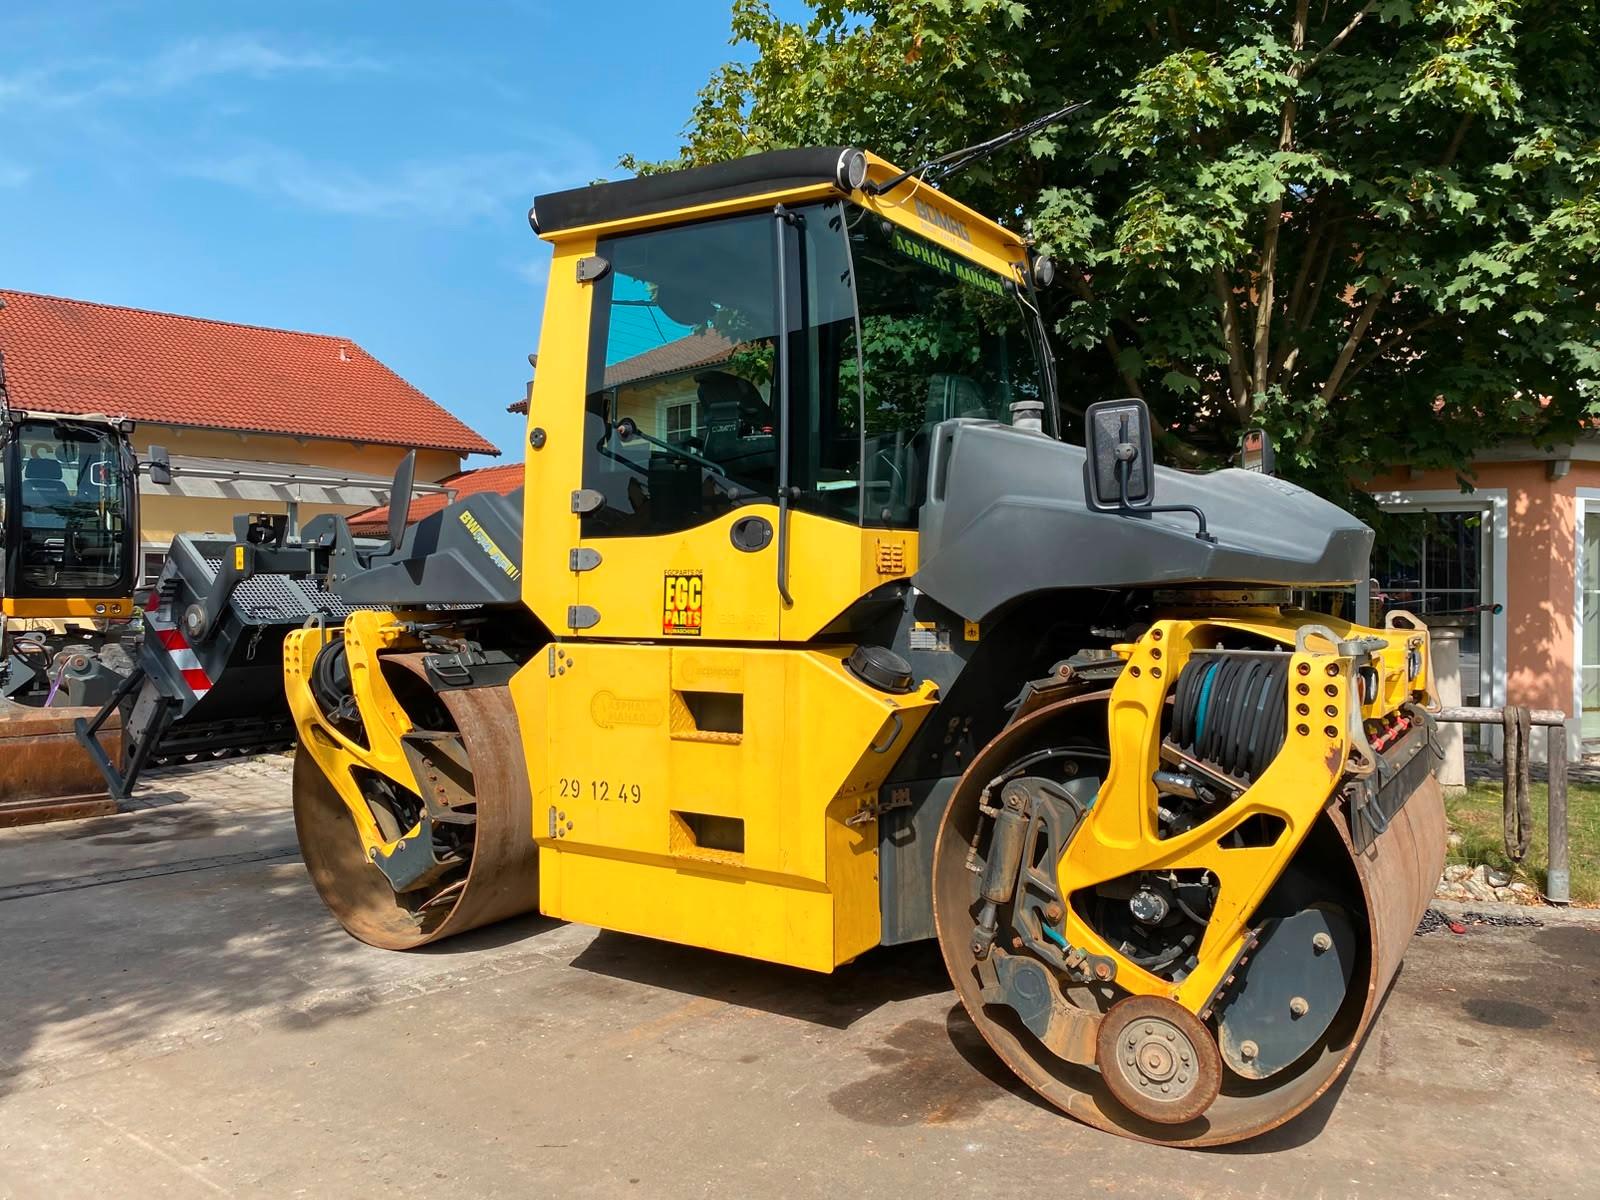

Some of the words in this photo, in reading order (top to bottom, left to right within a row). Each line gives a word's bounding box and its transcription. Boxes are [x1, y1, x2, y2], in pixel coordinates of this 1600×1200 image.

[896, 234, 950, 273] ASPHALT
[955, 263, 1004, 297] MANAGER
[459, 510, 480, 534] BW
[665, 577, 702, 611] EGC
[665, 610, 702, 626] PARTS
[559, 778, 581, 799] 29
[591, 780, 610, 801] 12
[618, 783, 641, 804] 49
